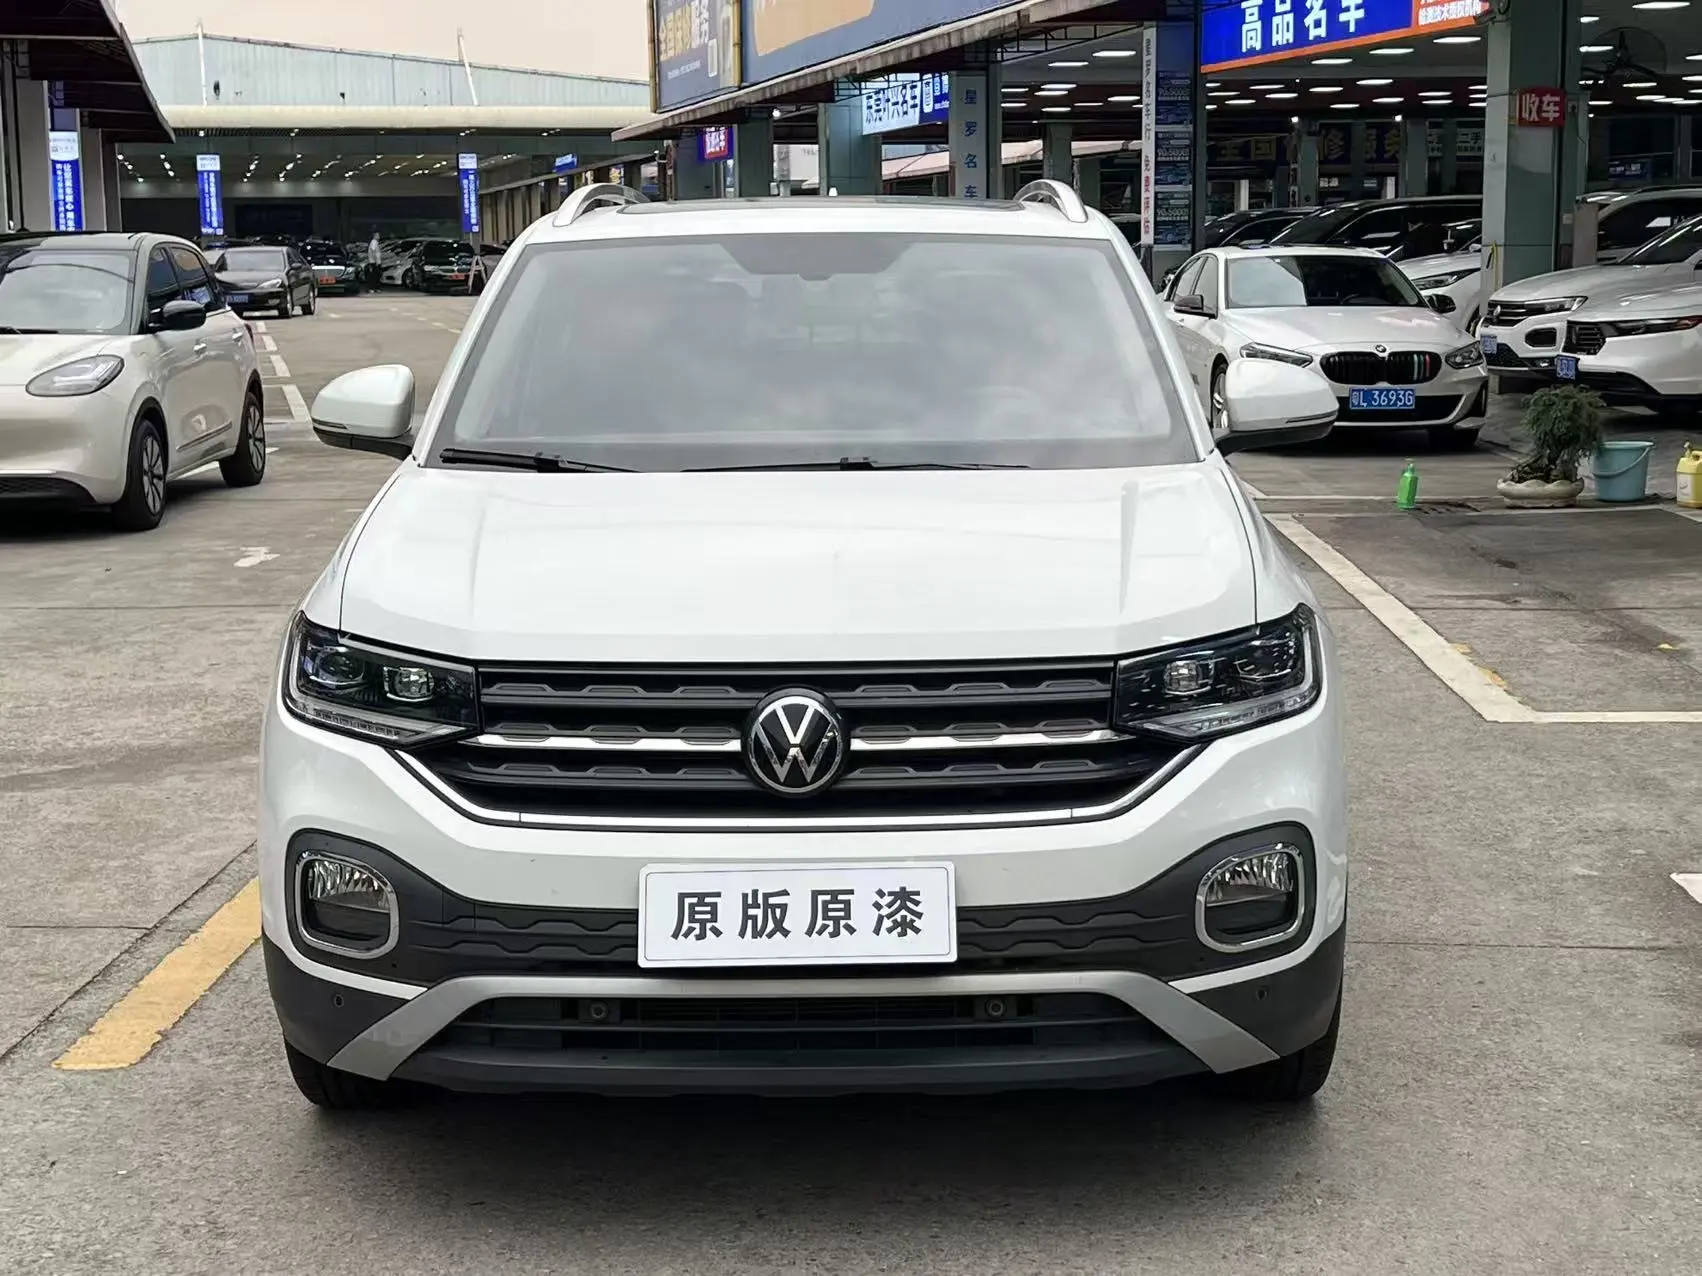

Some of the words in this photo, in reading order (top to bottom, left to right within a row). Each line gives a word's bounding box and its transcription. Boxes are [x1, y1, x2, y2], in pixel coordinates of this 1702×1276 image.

[1522, 93, 1560, 122] 收车
[963, 88, 978, 198] 星罗名车
[670, 886, 924, 940] 原版原漆
